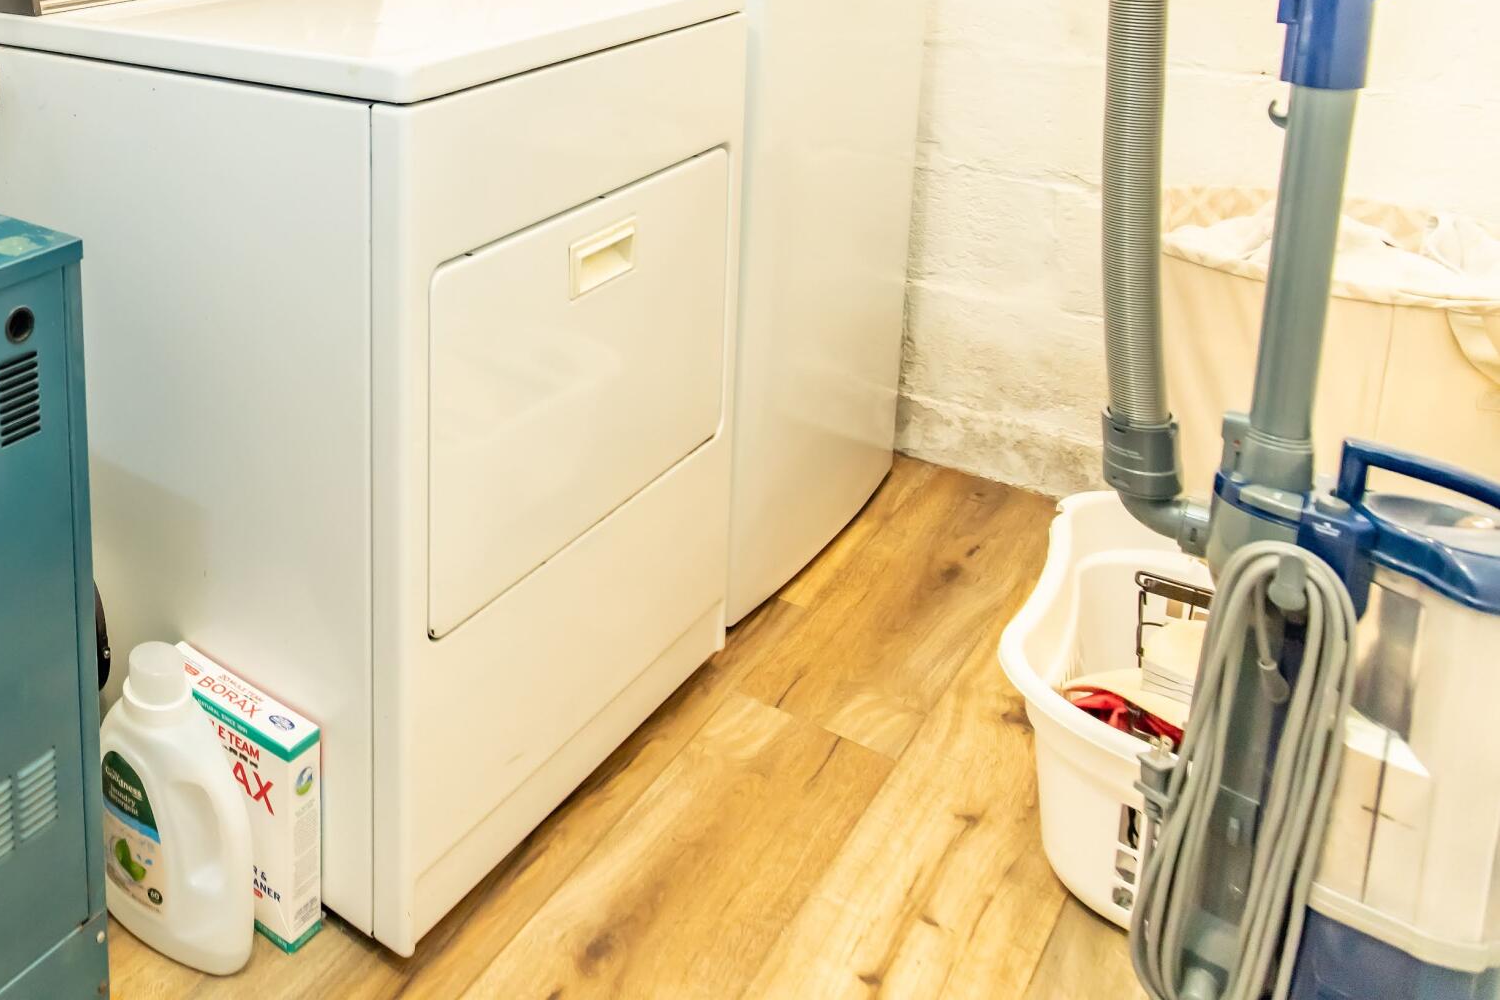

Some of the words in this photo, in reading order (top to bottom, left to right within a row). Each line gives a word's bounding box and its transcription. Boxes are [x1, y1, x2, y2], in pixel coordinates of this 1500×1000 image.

[197, 675, 262, 719] BORAX
[227, 731, 260, 761] TEAM
[253, 878, 281, 903] ANER
